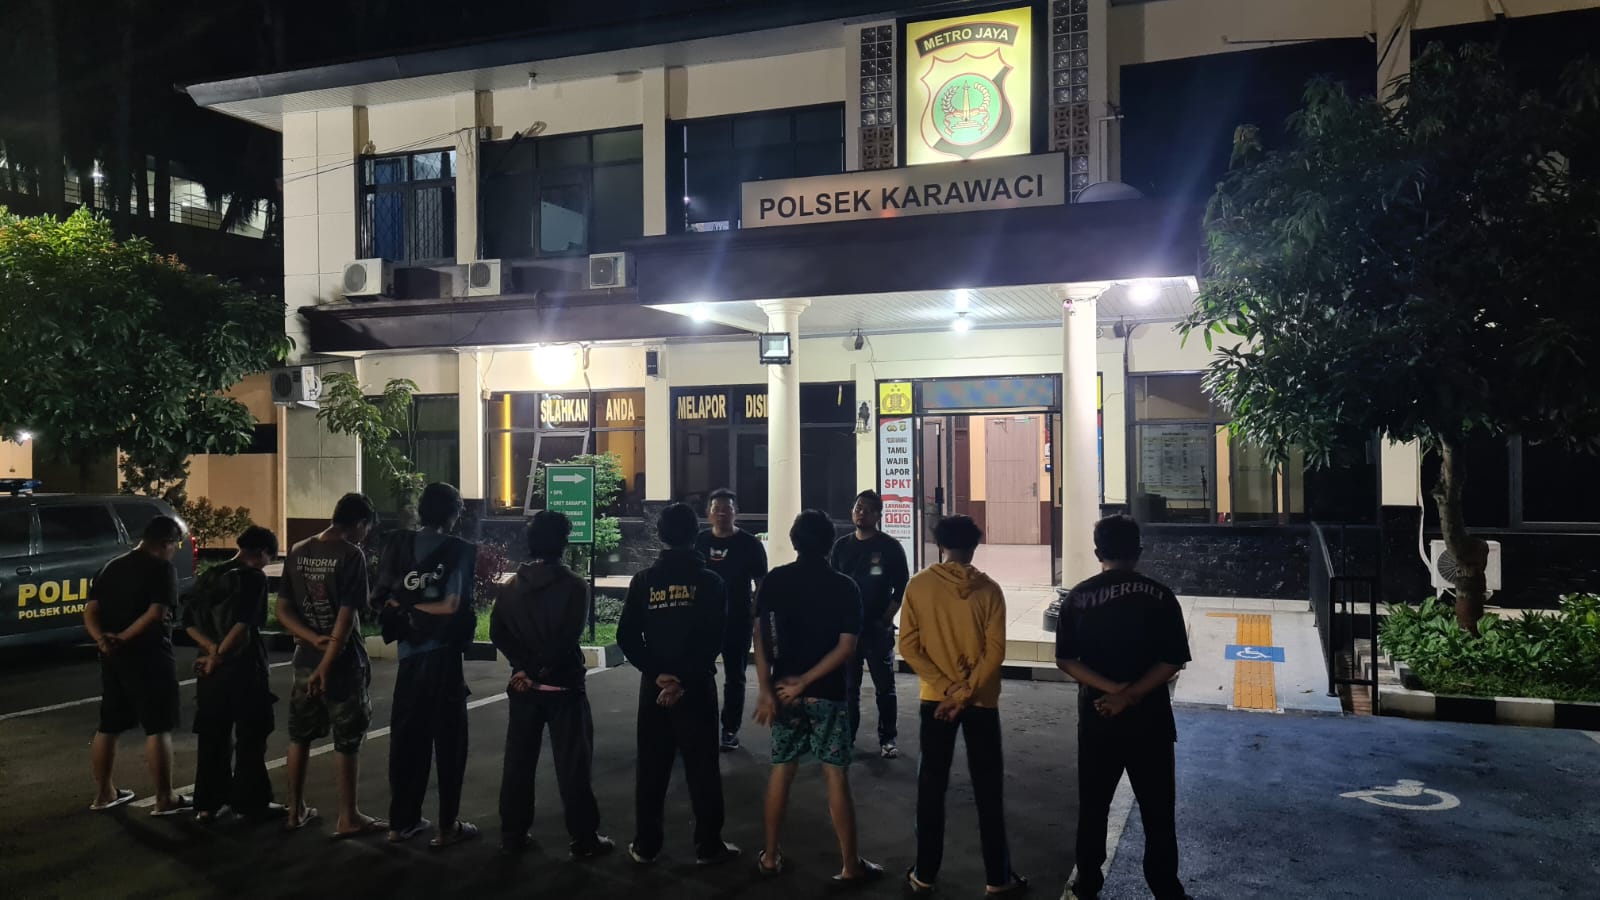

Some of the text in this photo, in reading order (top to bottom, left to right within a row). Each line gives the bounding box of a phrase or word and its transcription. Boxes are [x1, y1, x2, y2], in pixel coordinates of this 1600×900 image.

[923, 27, 1009, 51] METRO JAYA
[759, 174, 1043, 220] POLSEK KARAWACI
[540, 394, 769, 422] SILAHKAN ANDA MELAPOR DISI
[887, 446, 908, 454] TAMU
[886, 457, 909, 465] WAJIB
[885, 468, 910, 476] LAPOR
[884, 479, 911, 489] SPKT
[886, 514, 910, 523] 110
[297, 556, 337, 567] UNIFORM
[18, 578, 93, 607] POLI
[18, 606, 60, 620] POLSEK
